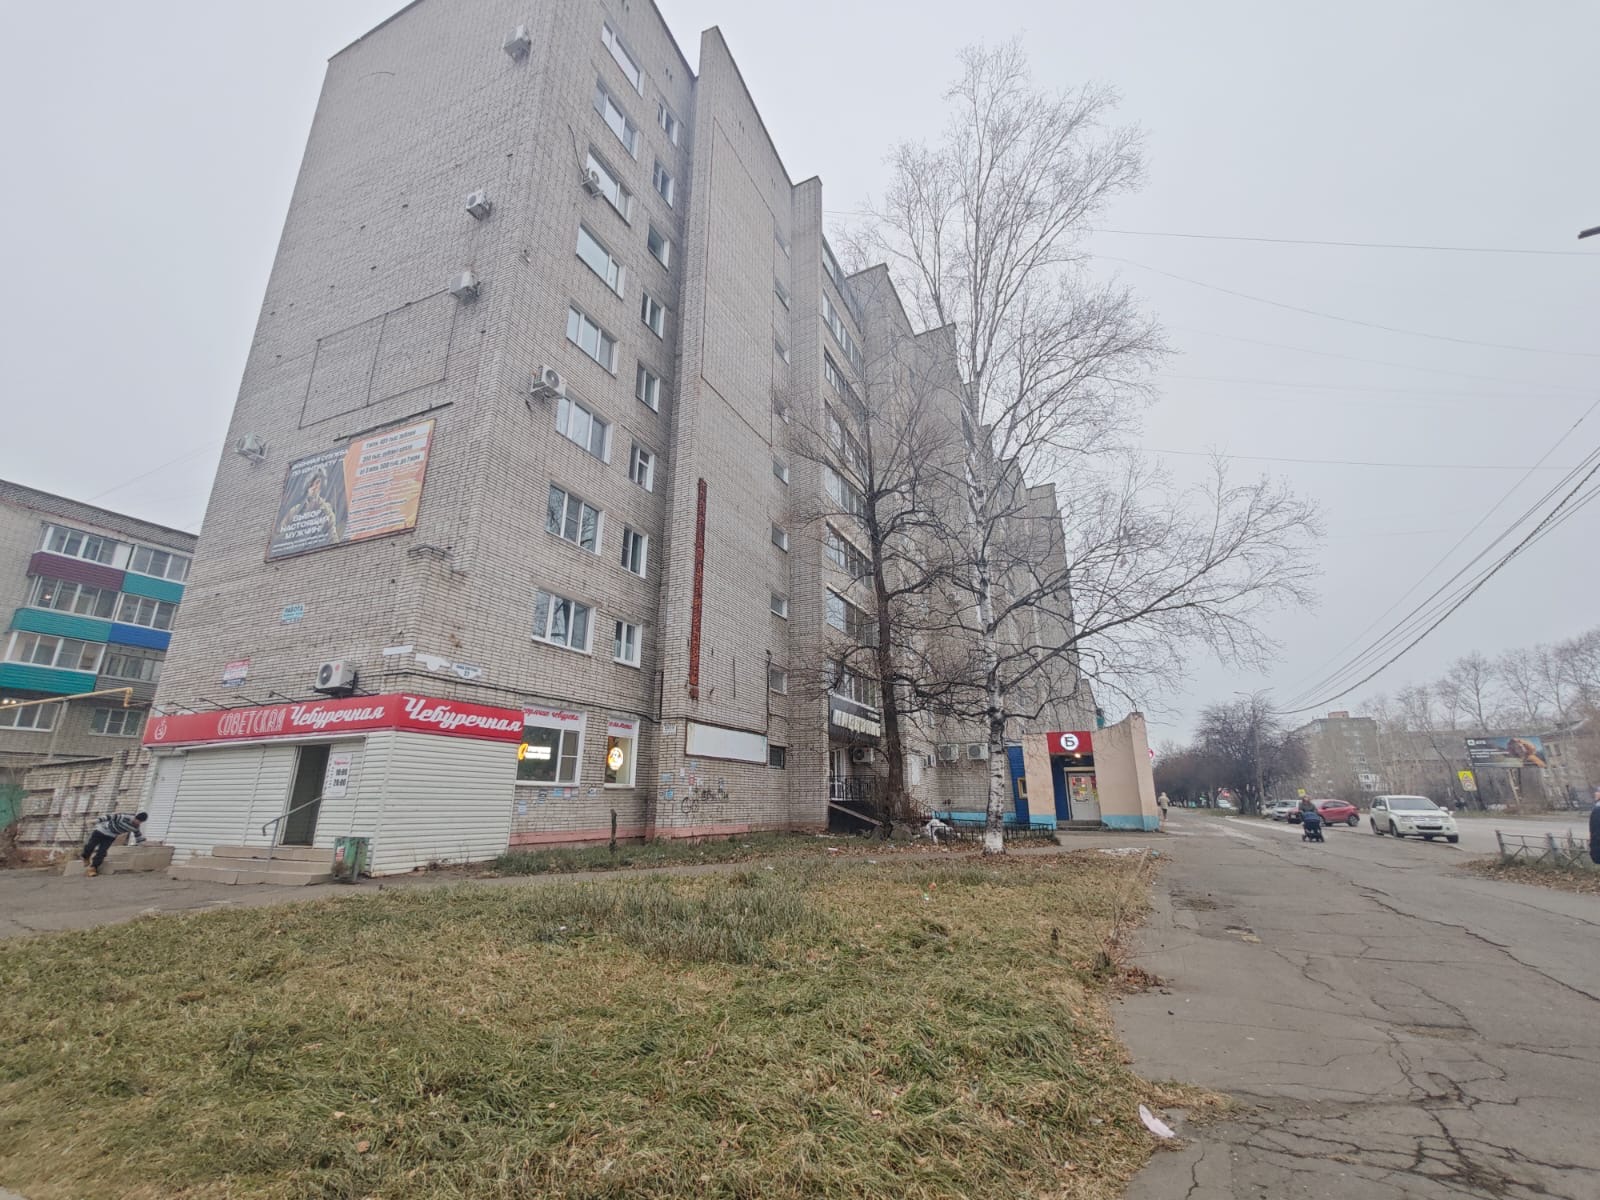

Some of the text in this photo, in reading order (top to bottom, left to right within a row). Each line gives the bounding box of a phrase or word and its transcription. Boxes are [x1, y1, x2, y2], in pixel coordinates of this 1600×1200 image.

[217, 705, 385, 736] СОВЕТСКАЯ Чебуречная
[402, 696, 523, 732] Чебуречная
[1064, 736, 1075, 747] Б
